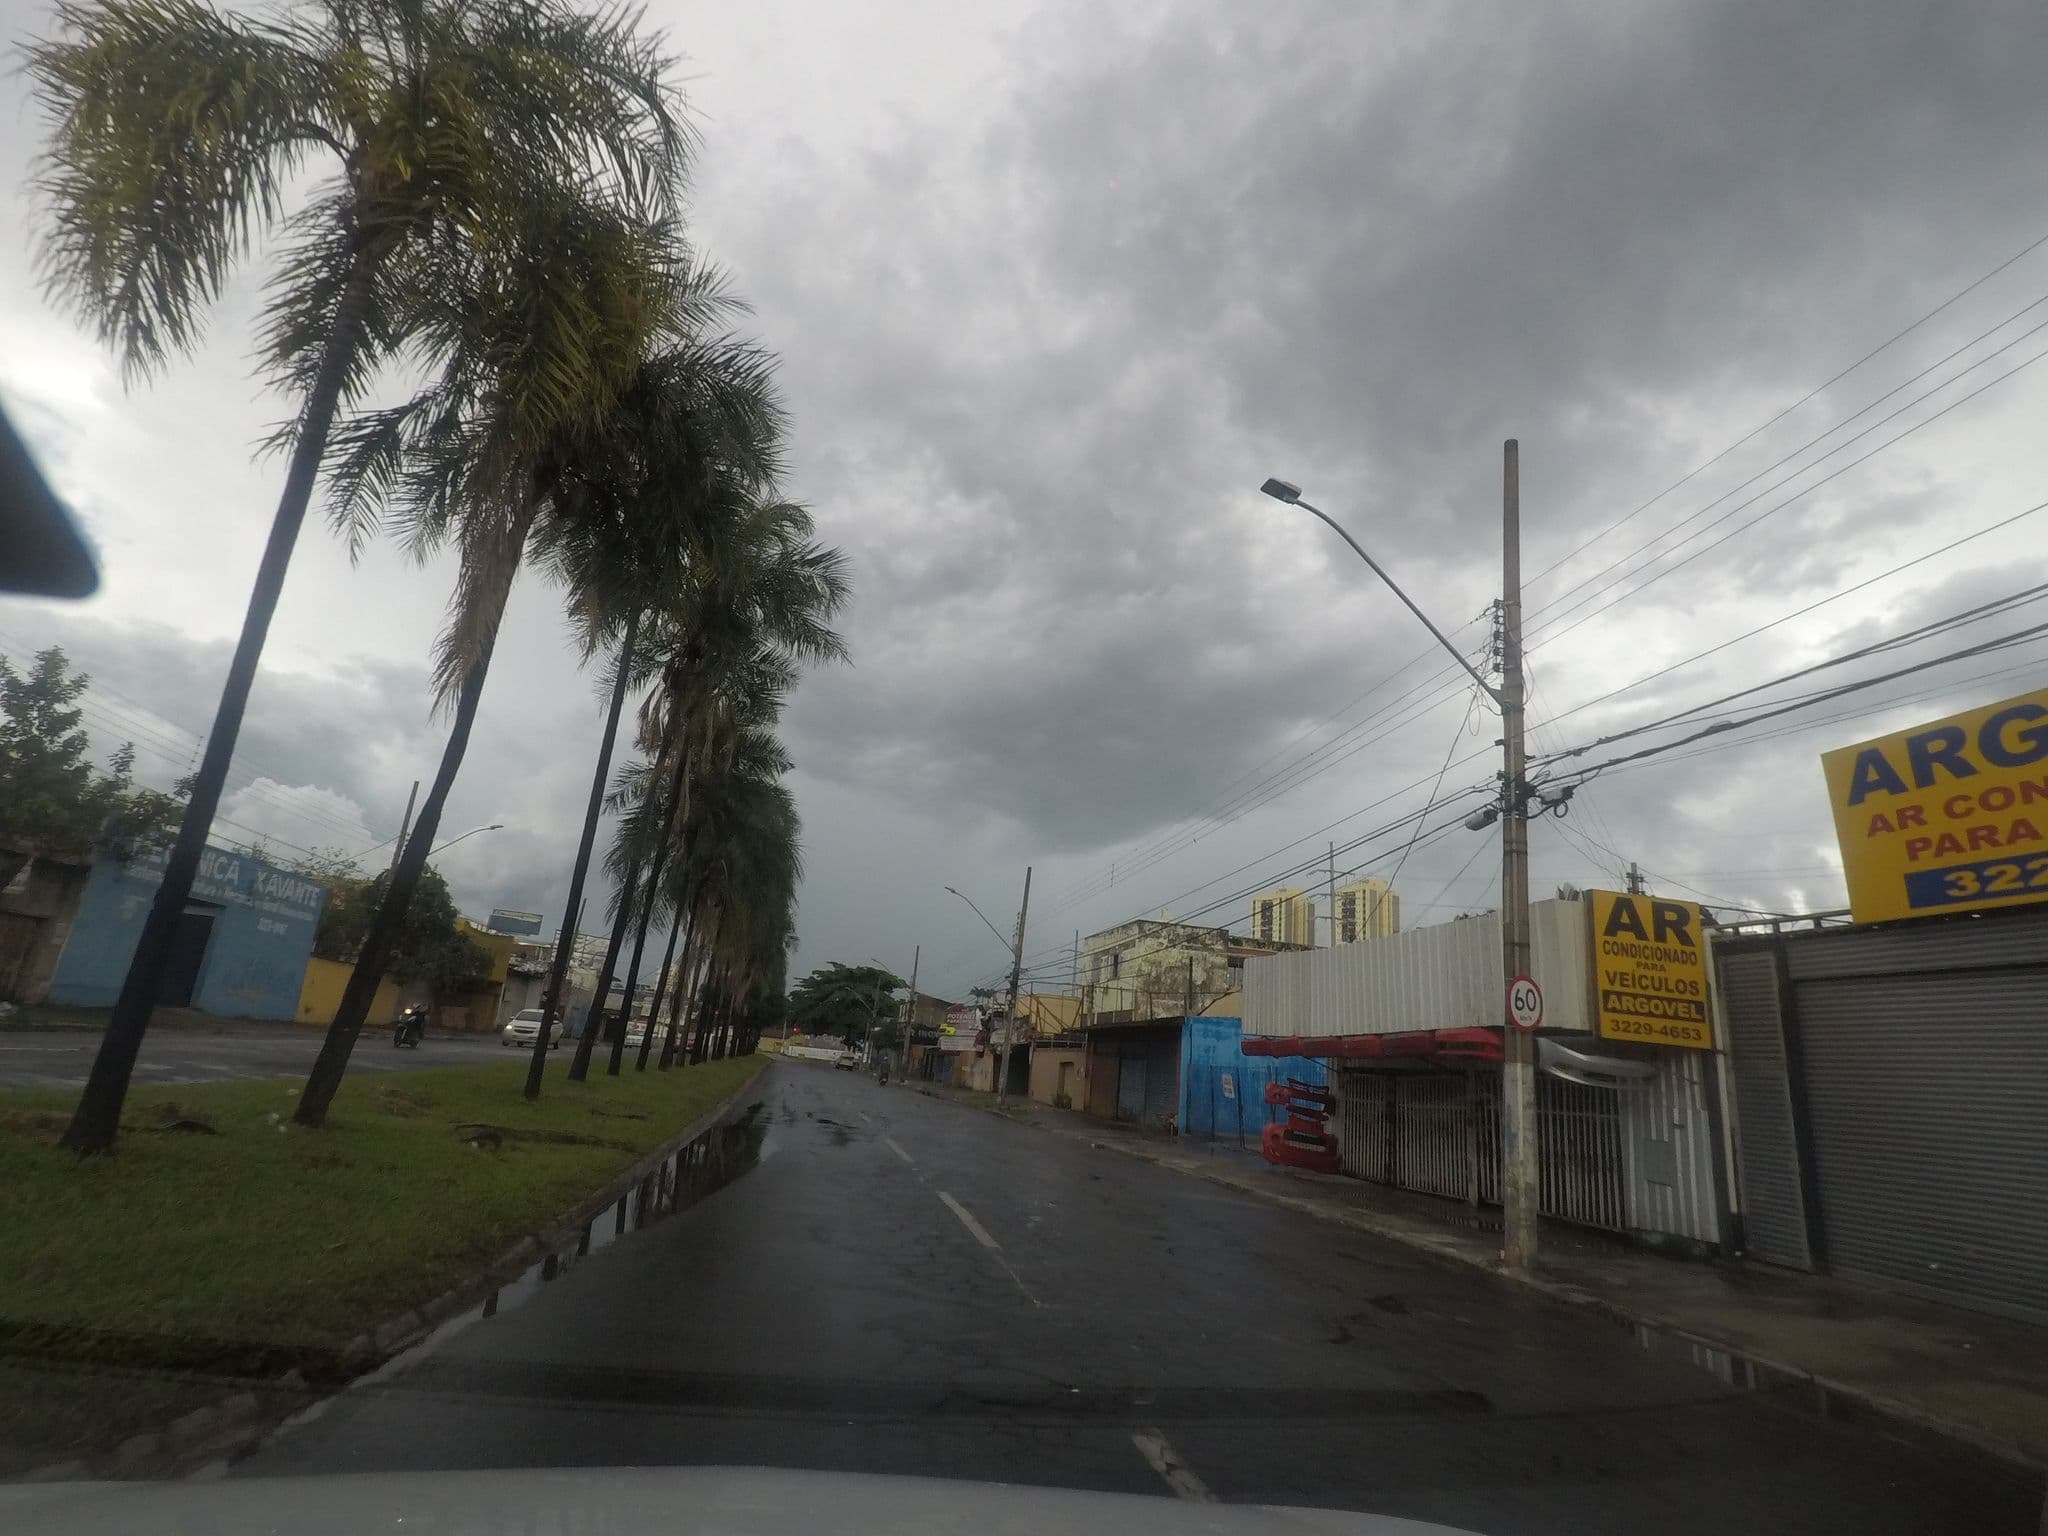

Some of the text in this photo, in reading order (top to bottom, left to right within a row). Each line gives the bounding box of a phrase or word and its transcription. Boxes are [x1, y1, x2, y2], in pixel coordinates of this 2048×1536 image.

[1848, 704, 2048, 807] ARG
[1867, 776, 2048, 838] AR CON
[1905, 818, 2043, 862] PARA
[255, 872, 320, 908] XAVANTE
[1603, 896, 1696, 947] AR
[1602, 940, 1697, 966] CONDICIONADO
[1636, 961, 1667, 973] PARA
[1515, 988, 1537, 1011] 60
[1608, 993, 1705, 1020] ARGOVEL
[1610, 1019, 1702, 1041] 3229-4653
